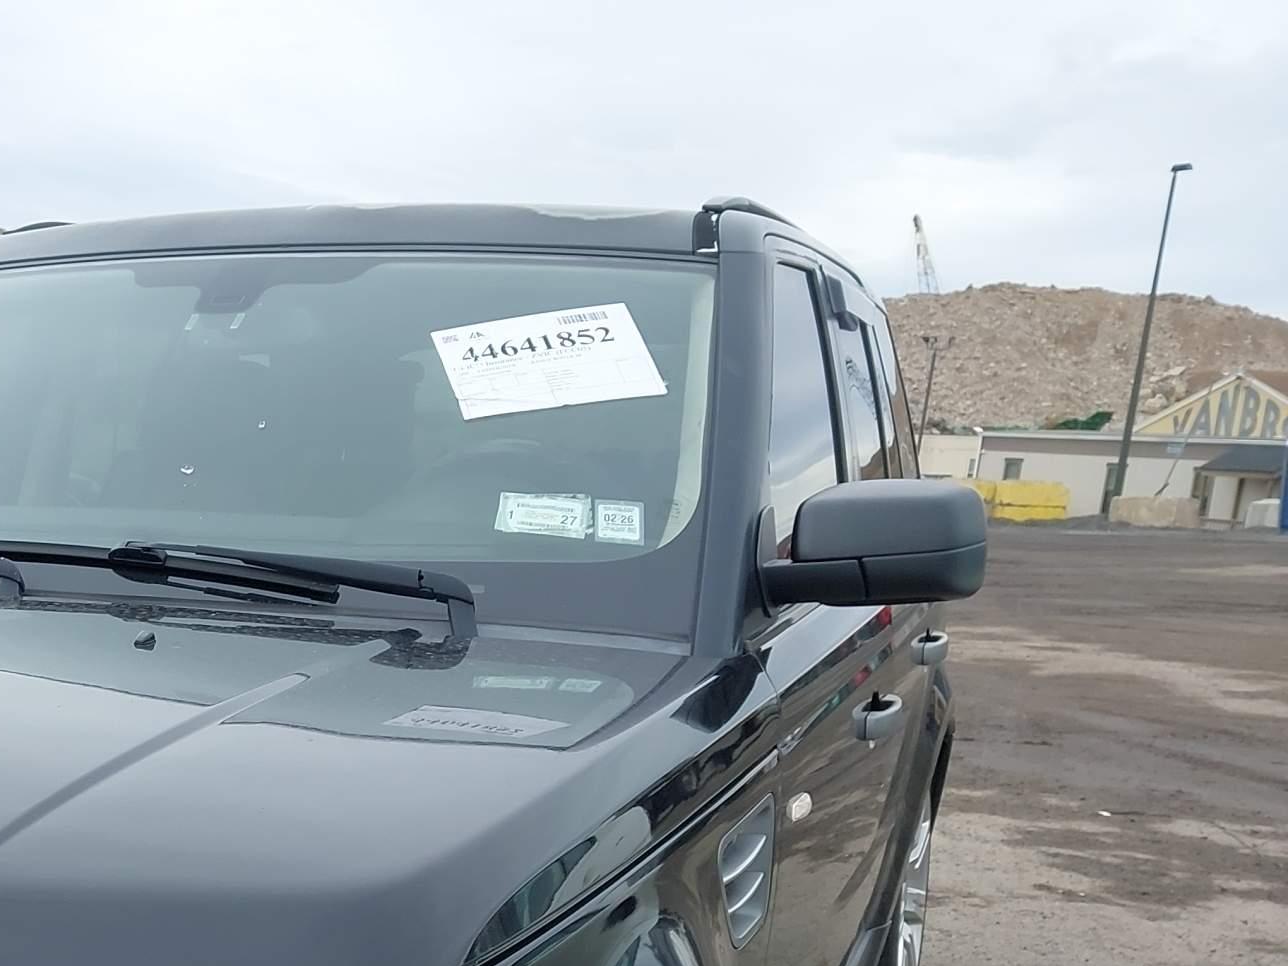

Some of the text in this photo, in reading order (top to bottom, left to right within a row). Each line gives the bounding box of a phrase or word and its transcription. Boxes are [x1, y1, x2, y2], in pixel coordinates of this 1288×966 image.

[463, 327, 614, 361] 44641852
[604, 513, 634, 524] 02 26
